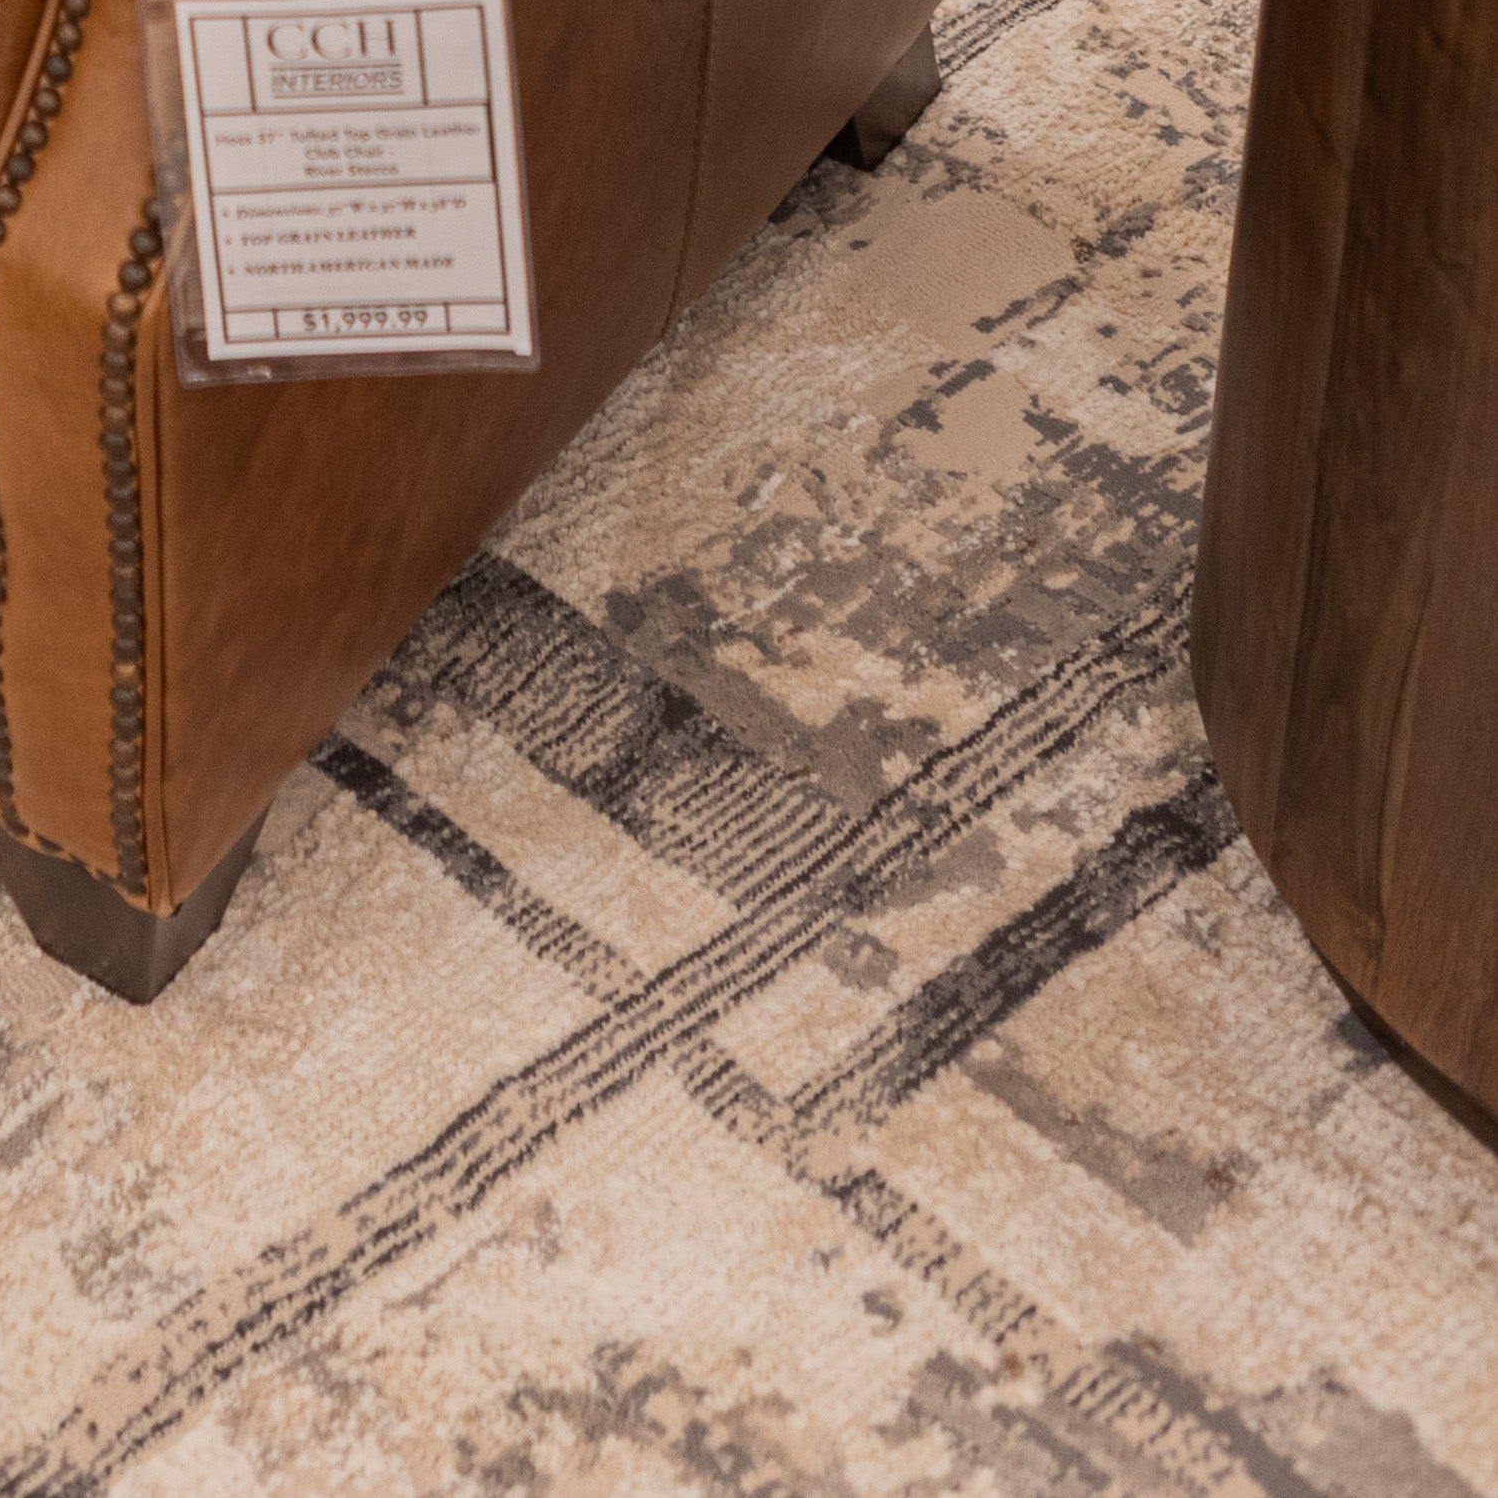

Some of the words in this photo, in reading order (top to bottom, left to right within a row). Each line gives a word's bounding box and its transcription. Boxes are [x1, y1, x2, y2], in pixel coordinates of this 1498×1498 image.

[266, 19, 397, 61] CCH
[272, 70, 403, 93] INTERIORS
[241, 232, 274, 247] TOP
[336, 225, 417, 243] LEATHER
[245, 259, 304, 277] NORTH
[308, 256, 400, 275] AMERICAN
[405, 254, 455, 271] MADE
[303, 309, 428, 334] $1,999.99
